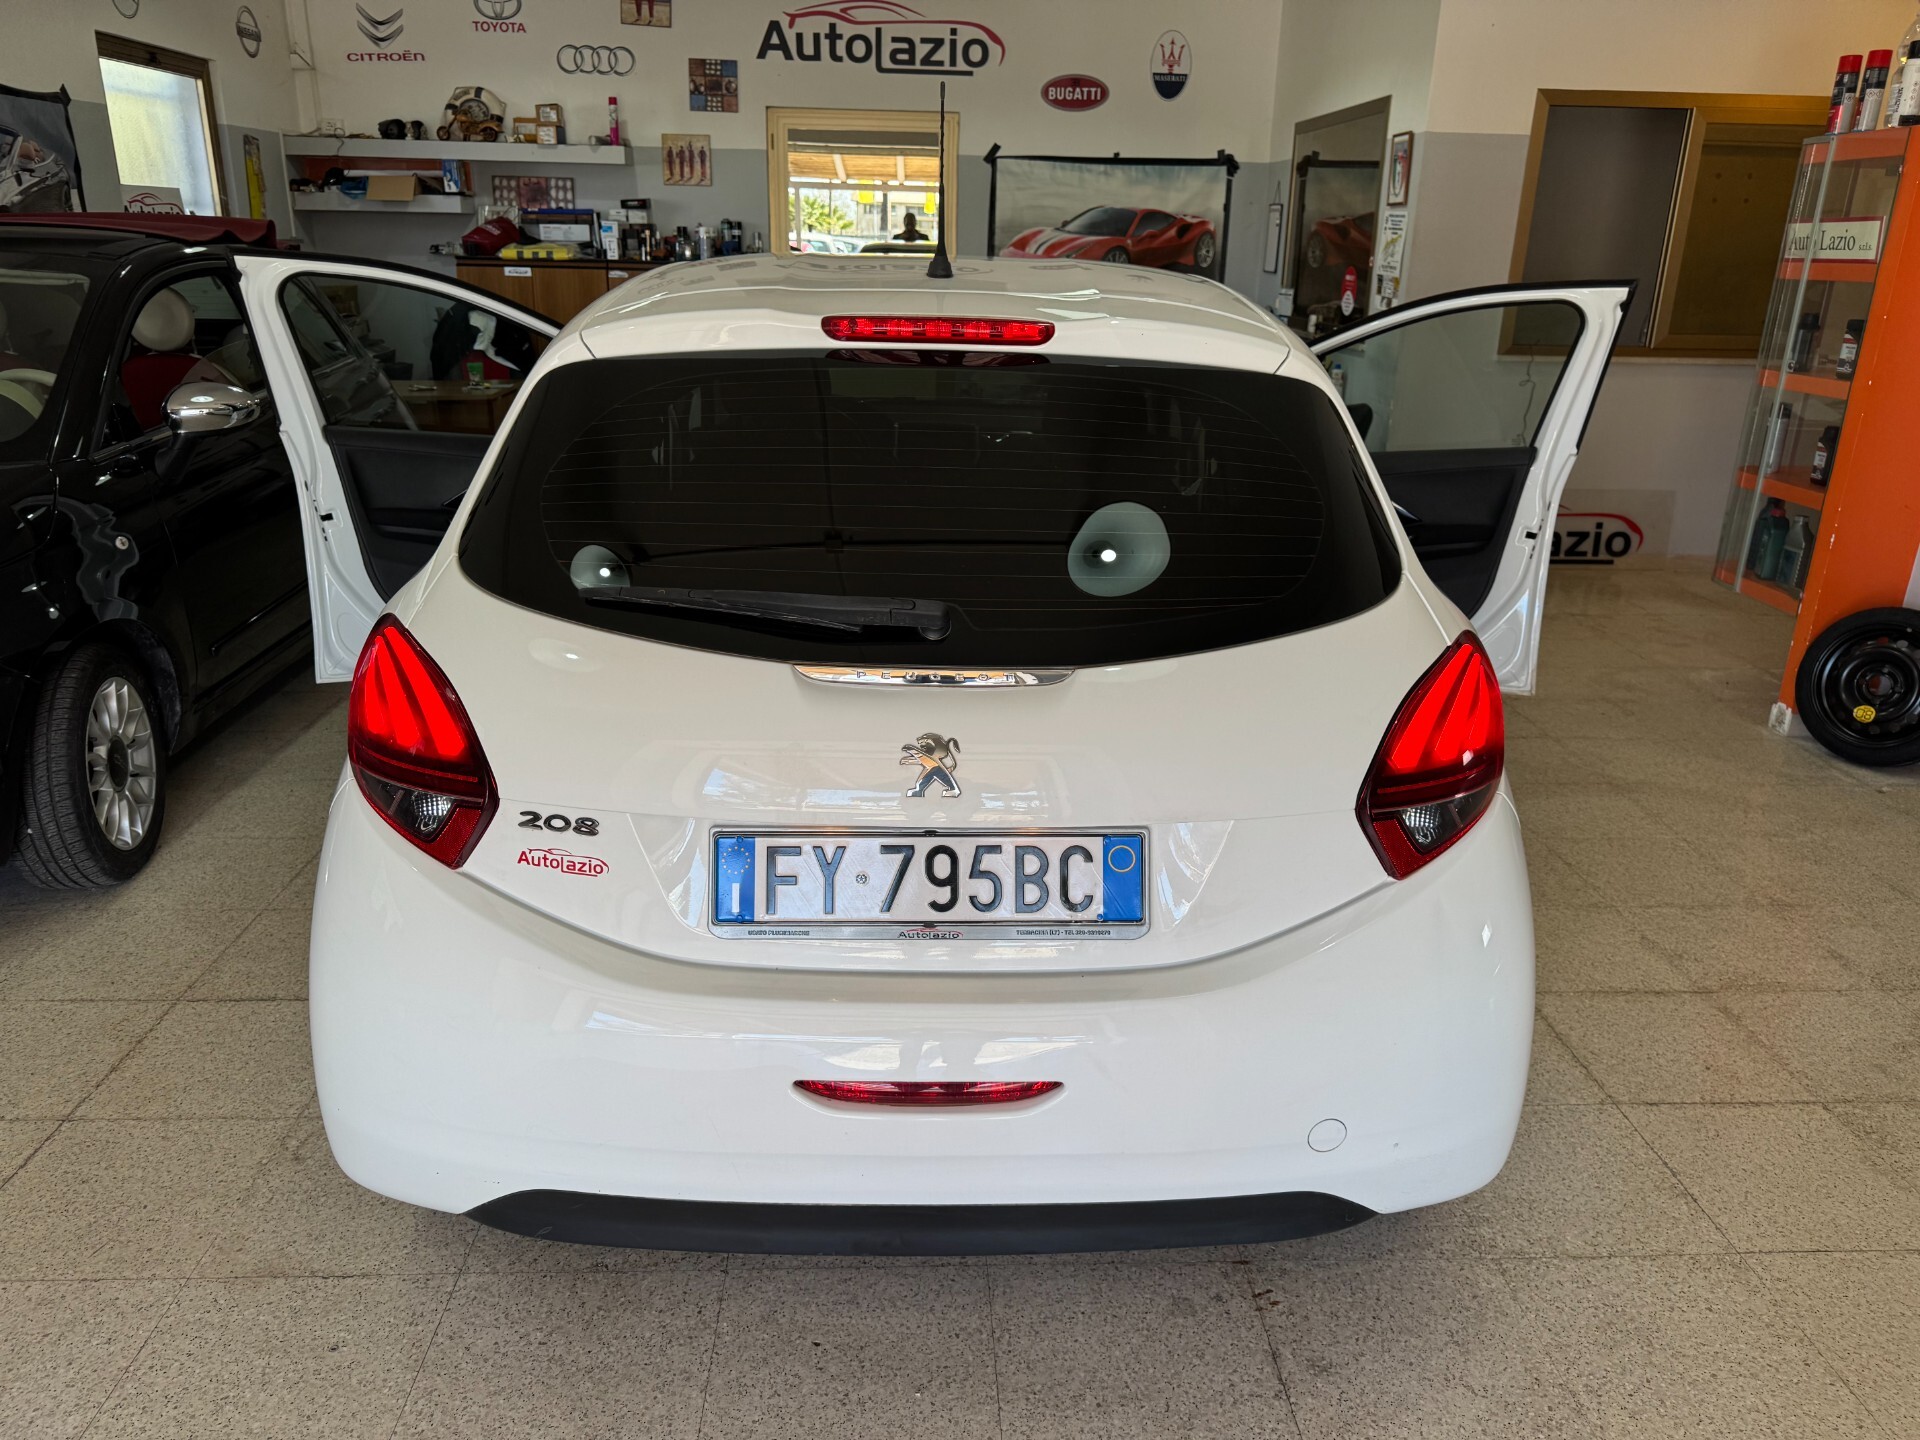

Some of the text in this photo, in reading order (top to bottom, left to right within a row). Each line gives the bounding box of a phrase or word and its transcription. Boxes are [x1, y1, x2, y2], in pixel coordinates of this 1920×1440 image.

[472, 21, 527, 33] TOYOTA
[1048, 87, 1101, 101] BUGATTI
[1819, 229, 1856, 251] Lazio
[856, 671, 1015, 681] PEUGEOT
[518, 811, 600, 837] 208
[766, 844, 1094, 915] FY 795BC
